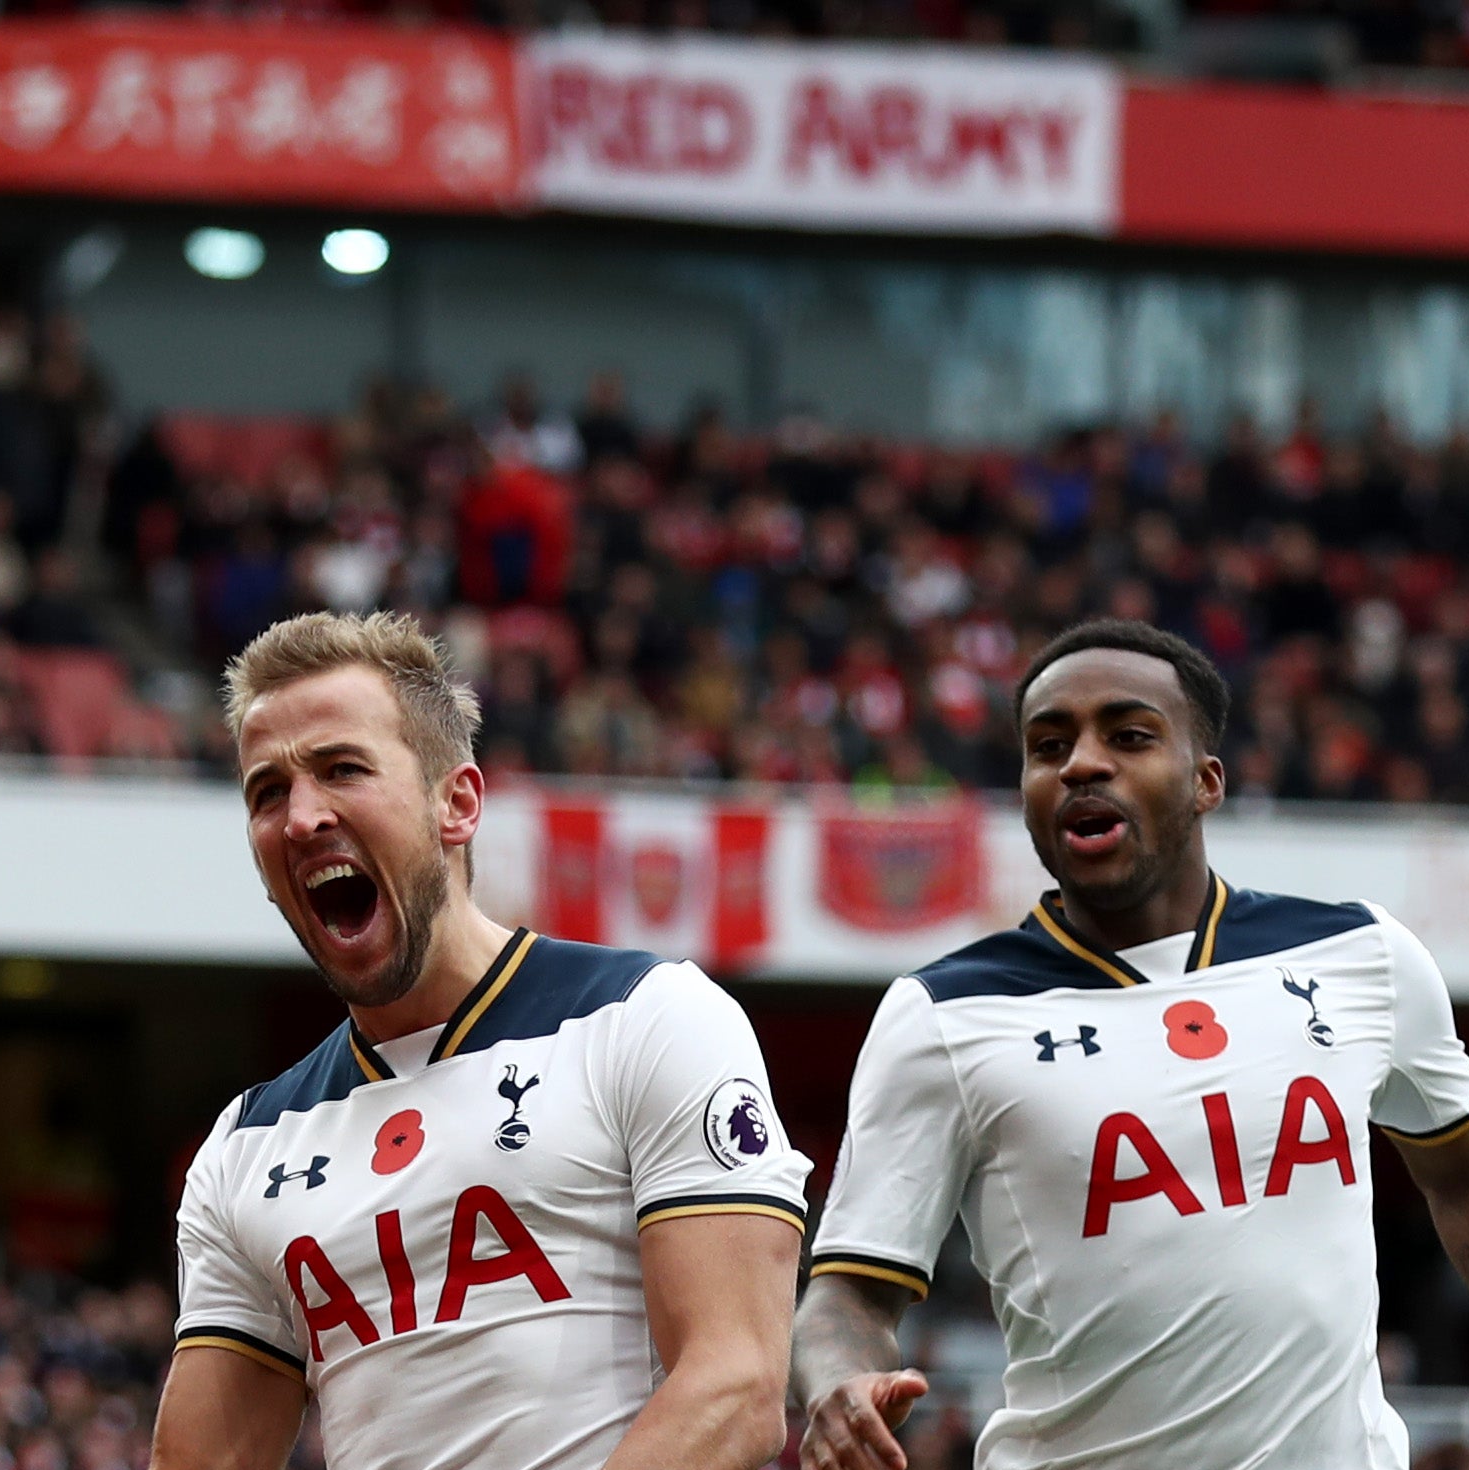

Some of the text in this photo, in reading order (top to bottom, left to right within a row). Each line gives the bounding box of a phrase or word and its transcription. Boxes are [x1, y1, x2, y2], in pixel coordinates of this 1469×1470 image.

[782, 76, 1078, 190] ARMY
[710, 1114, 748, 1167] Premier Leagu
[1082, 1076, 1356, 1238] AIA
[284, 1185, 572, 1362] AIA
